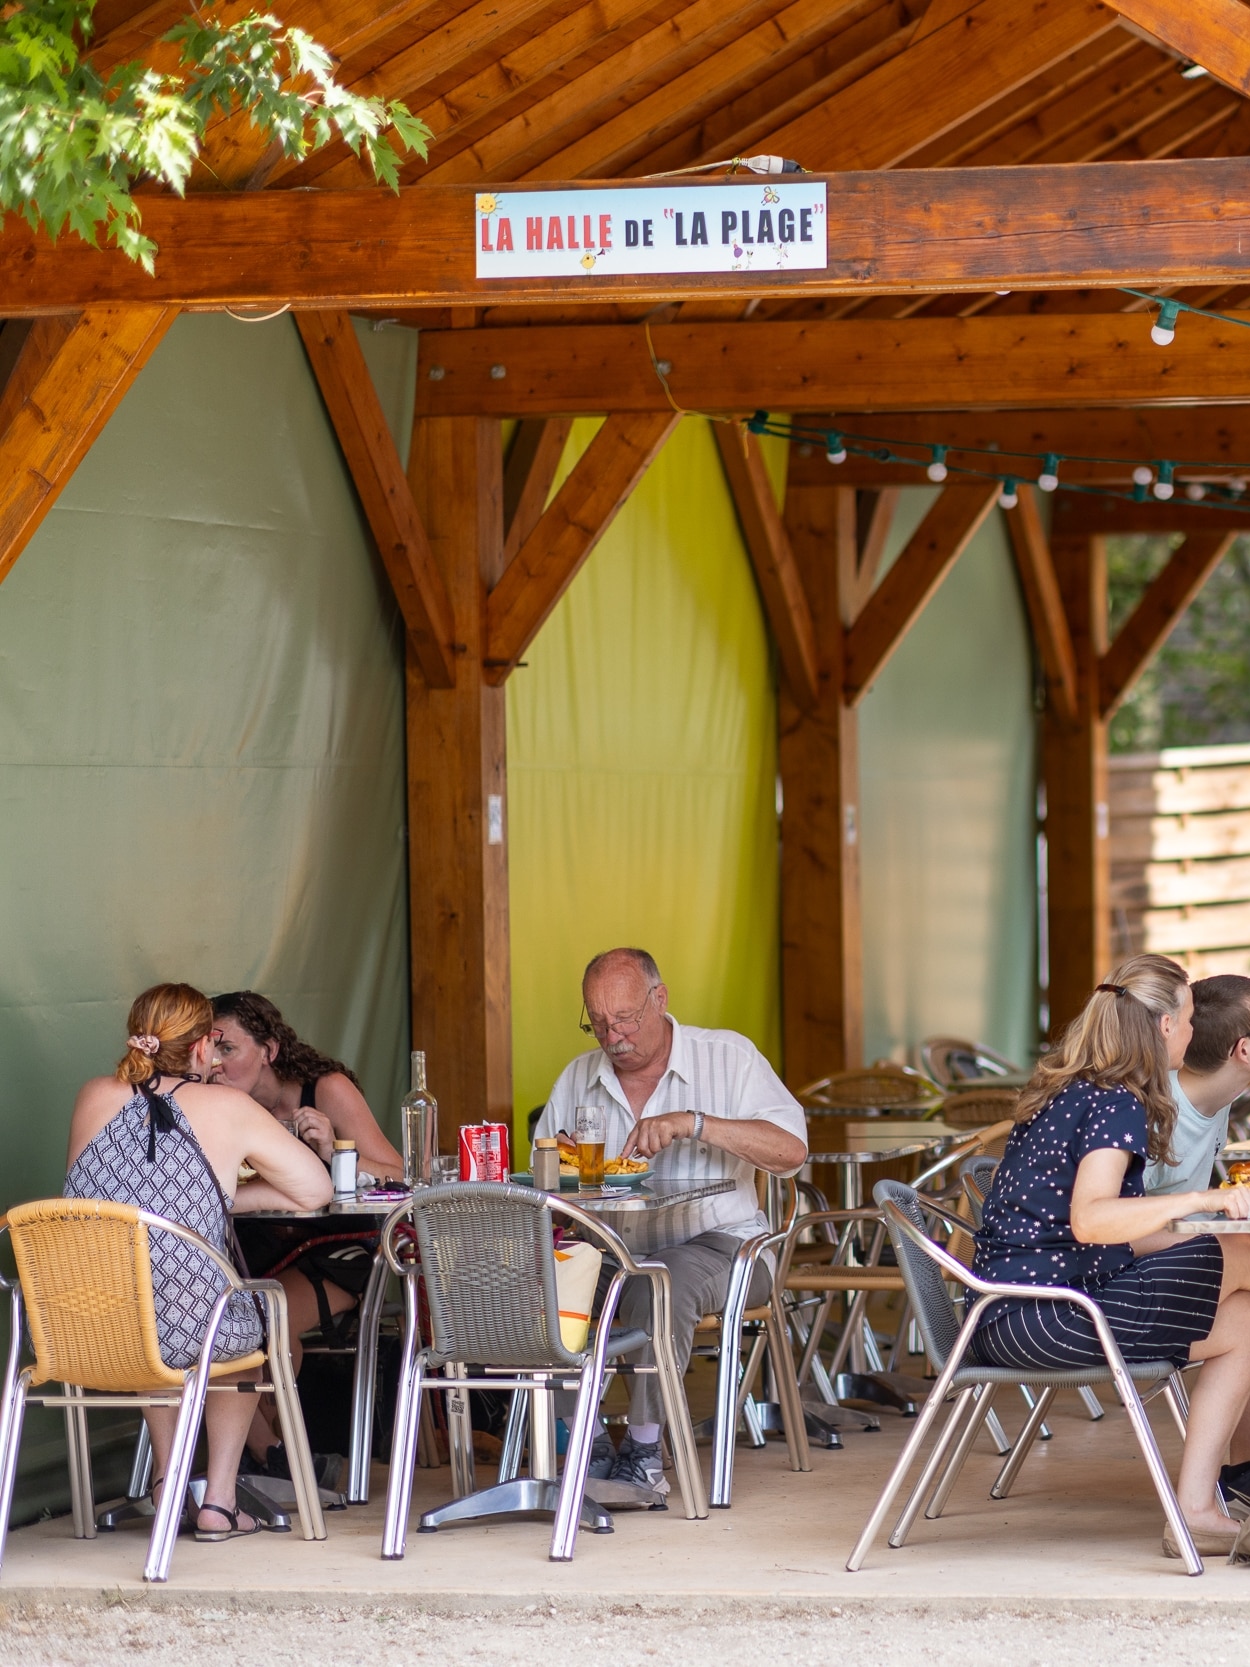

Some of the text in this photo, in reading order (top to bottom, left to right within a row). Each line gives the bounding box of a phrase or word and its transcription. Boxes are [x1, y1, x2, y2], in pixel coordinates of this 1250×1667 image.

[482, 218, 513, 251] LA
[526, 214, 612, 250] HALLE
[625, 219, 653, 247] DE
